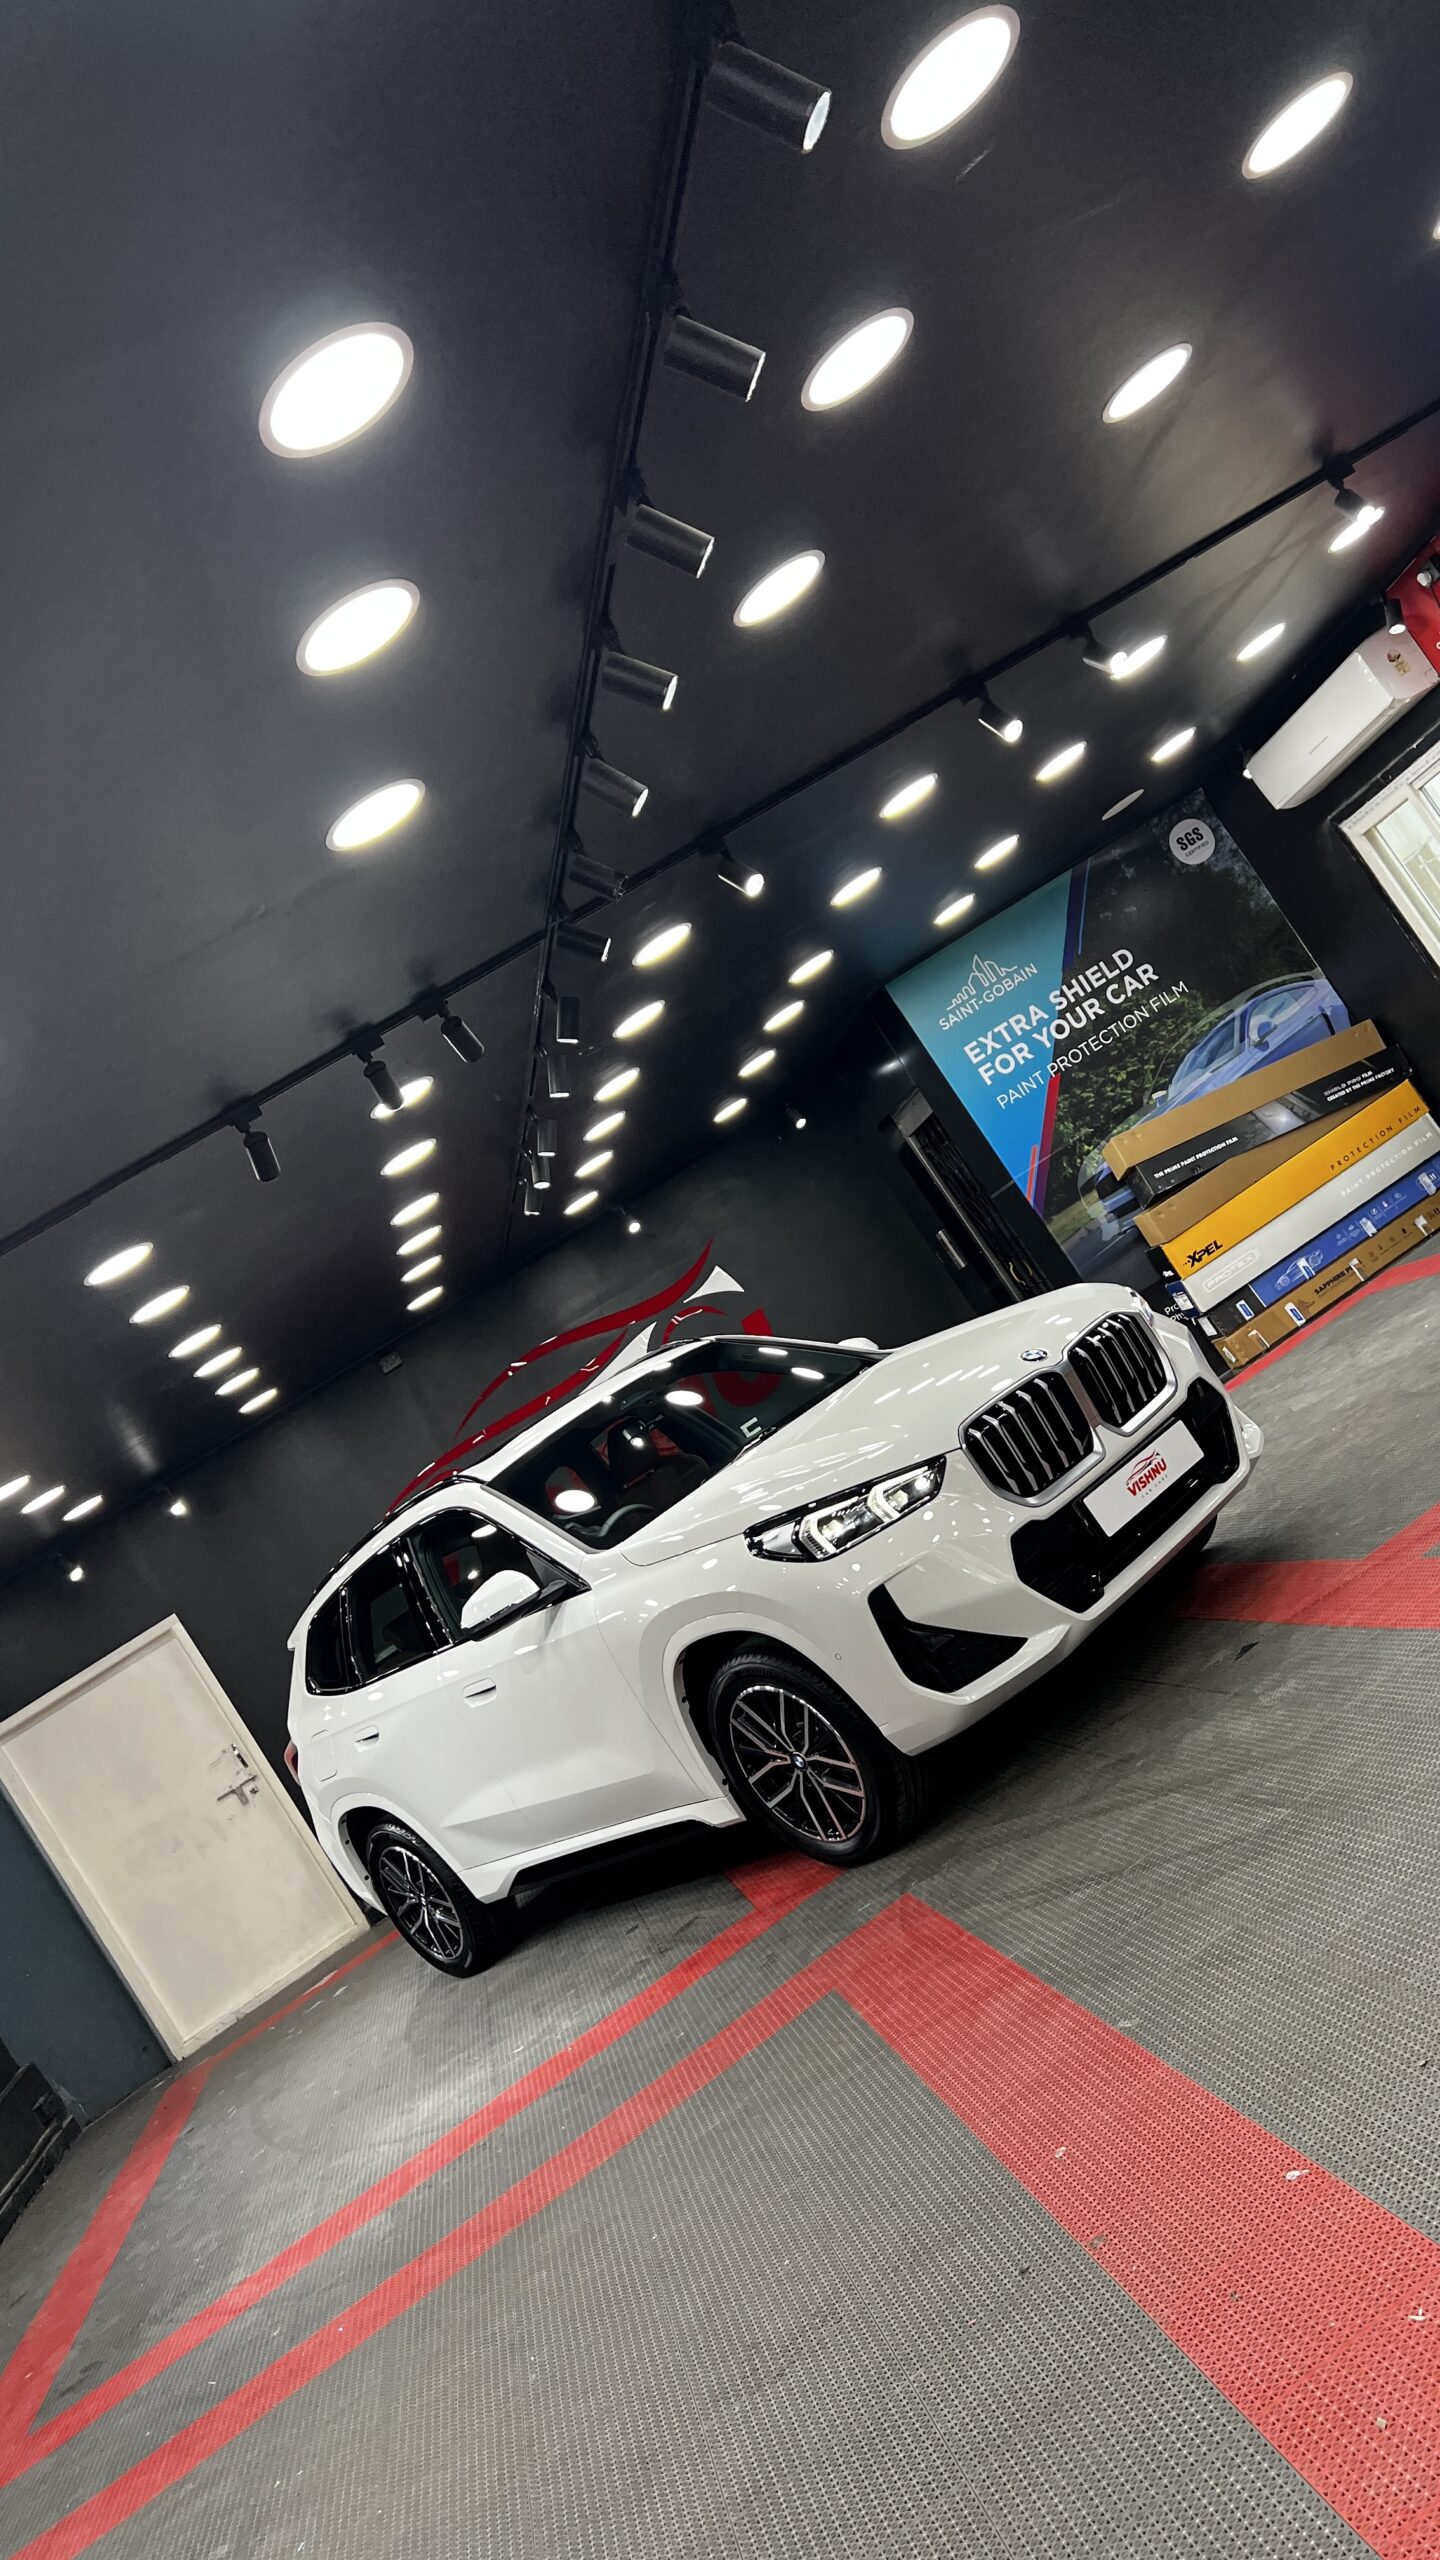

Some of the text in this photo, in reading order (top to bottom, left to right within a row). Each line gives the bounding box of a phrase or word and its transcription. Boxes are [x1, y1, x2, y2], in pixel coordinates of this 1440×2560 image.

[1176, 827, 1204, 851] SGS
[939, 963, 1038, 1031] SAINT-GOBAIN
[963, 948, 1134, 1065] EXTRA SHIELD
[977, 963, 1160, 1086] FOR YOUR CAR
[996, 980, 1189, 1109] PAINT PROTECTION FILM
[1153, 1170, 1164, 1179] THE
[1180, 1155, 1197, 1167] PAINT
[1195, 1141, 1227, 1160] PROTECTION
[1225, 1136, 1239, 1146] FILM
[1329, 1106, 1421, 1171] PROTECTION FILM
[1340, 1178, 1364, 1198] PAINT
[1365, 1144, 1414, 1180] PROTECTION
[1413, 1131, 1433, 1147] FILM
[1186, 1240, 1223, 1269] XPEL
[1206, 1253, 1255, 1288] PROTEX
[1314, 1270, 1346, 1295] SAPPHIRE
[1126, 1458, 1167, 1497] VISHNU
